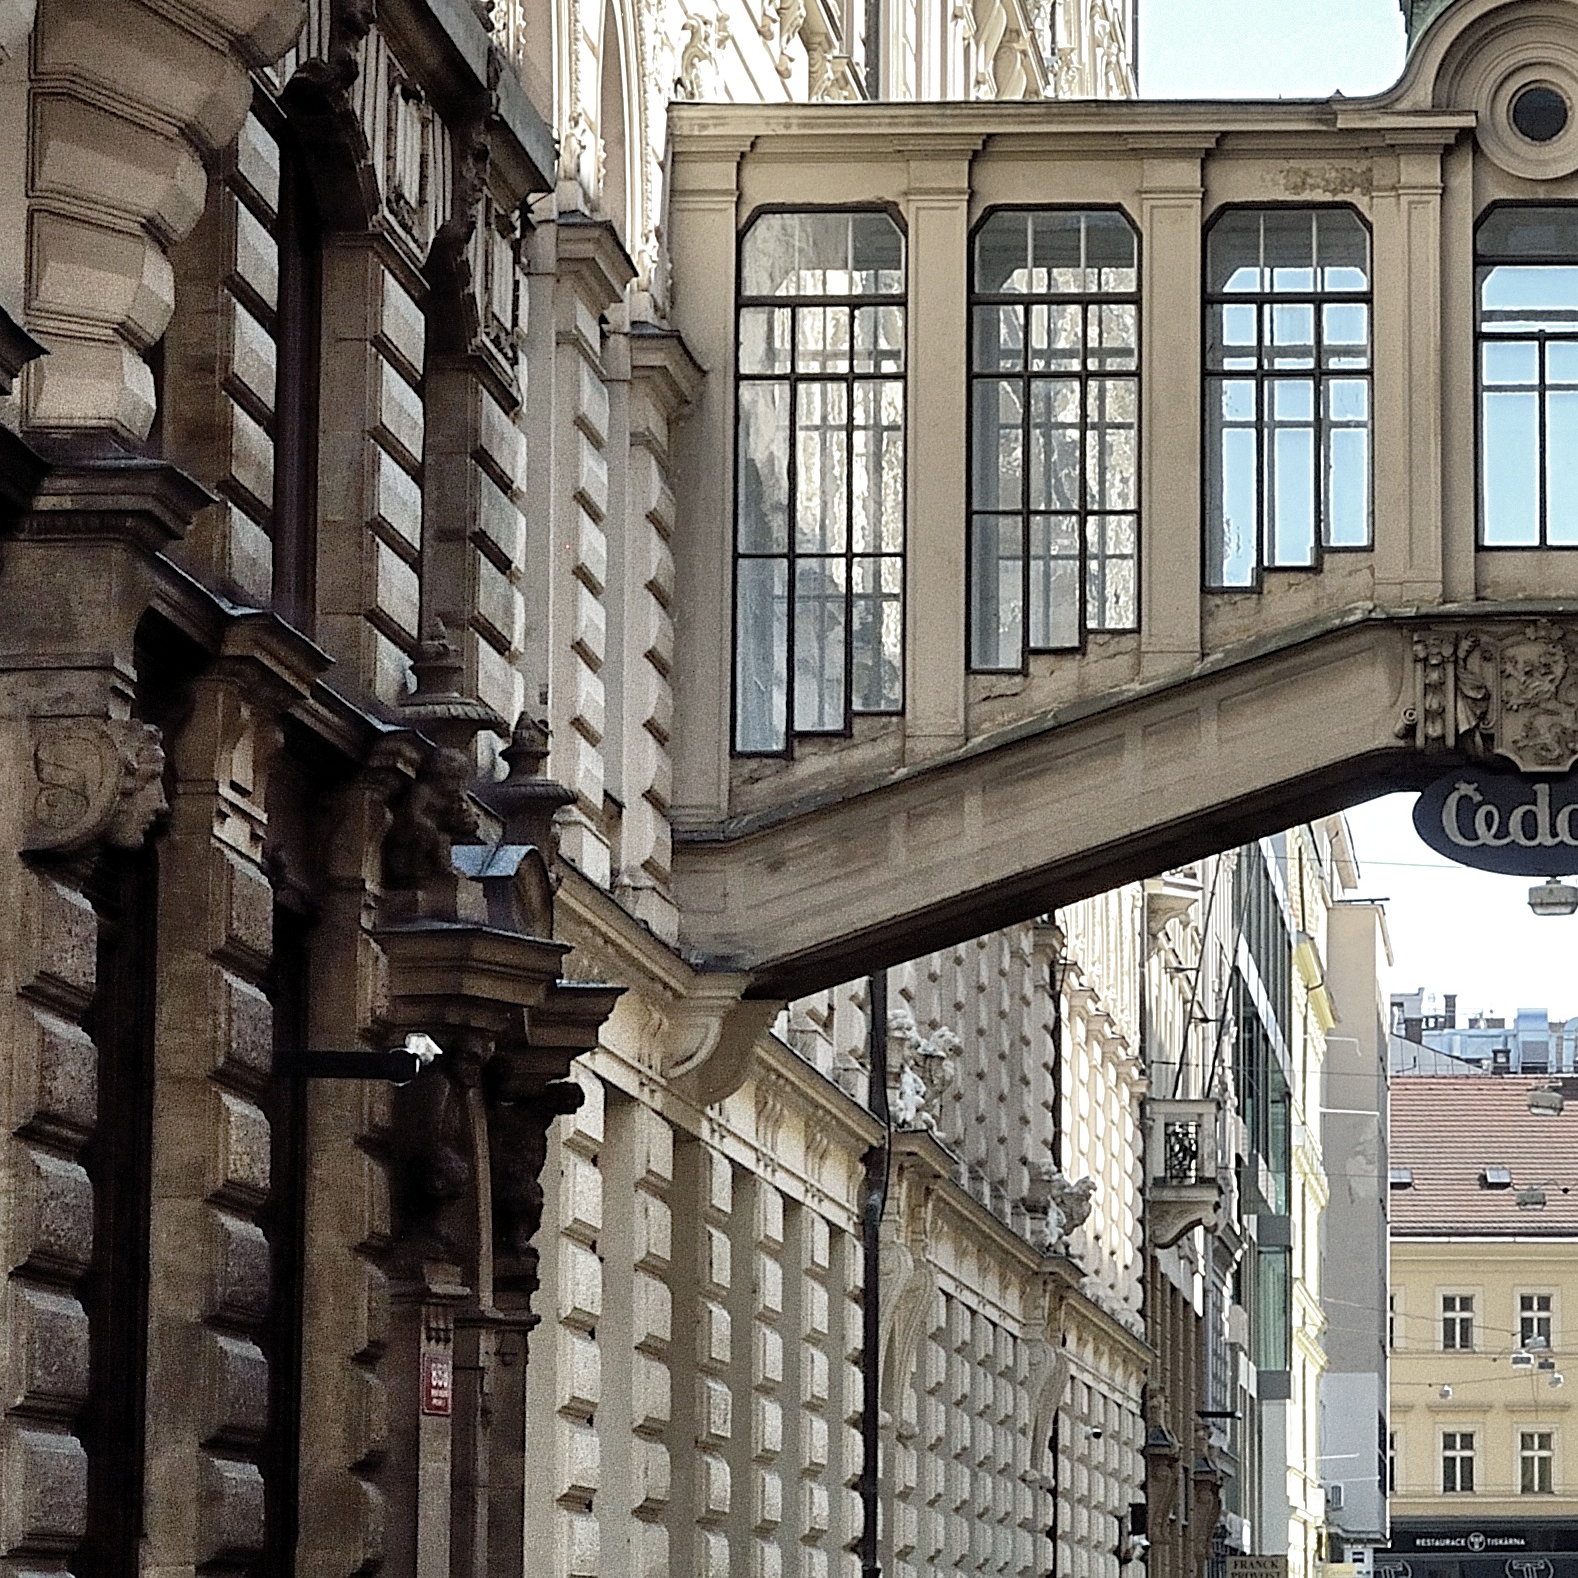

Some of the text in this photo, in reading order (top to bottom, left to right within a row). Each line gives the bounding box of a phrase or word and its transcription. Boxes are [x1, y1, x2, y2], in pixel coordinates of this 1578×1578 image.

[1415, 1537, 1525, 1547] RESTAURACE TISKÁRNA
[1233, 1559, 1279, 1570] FRANCK
